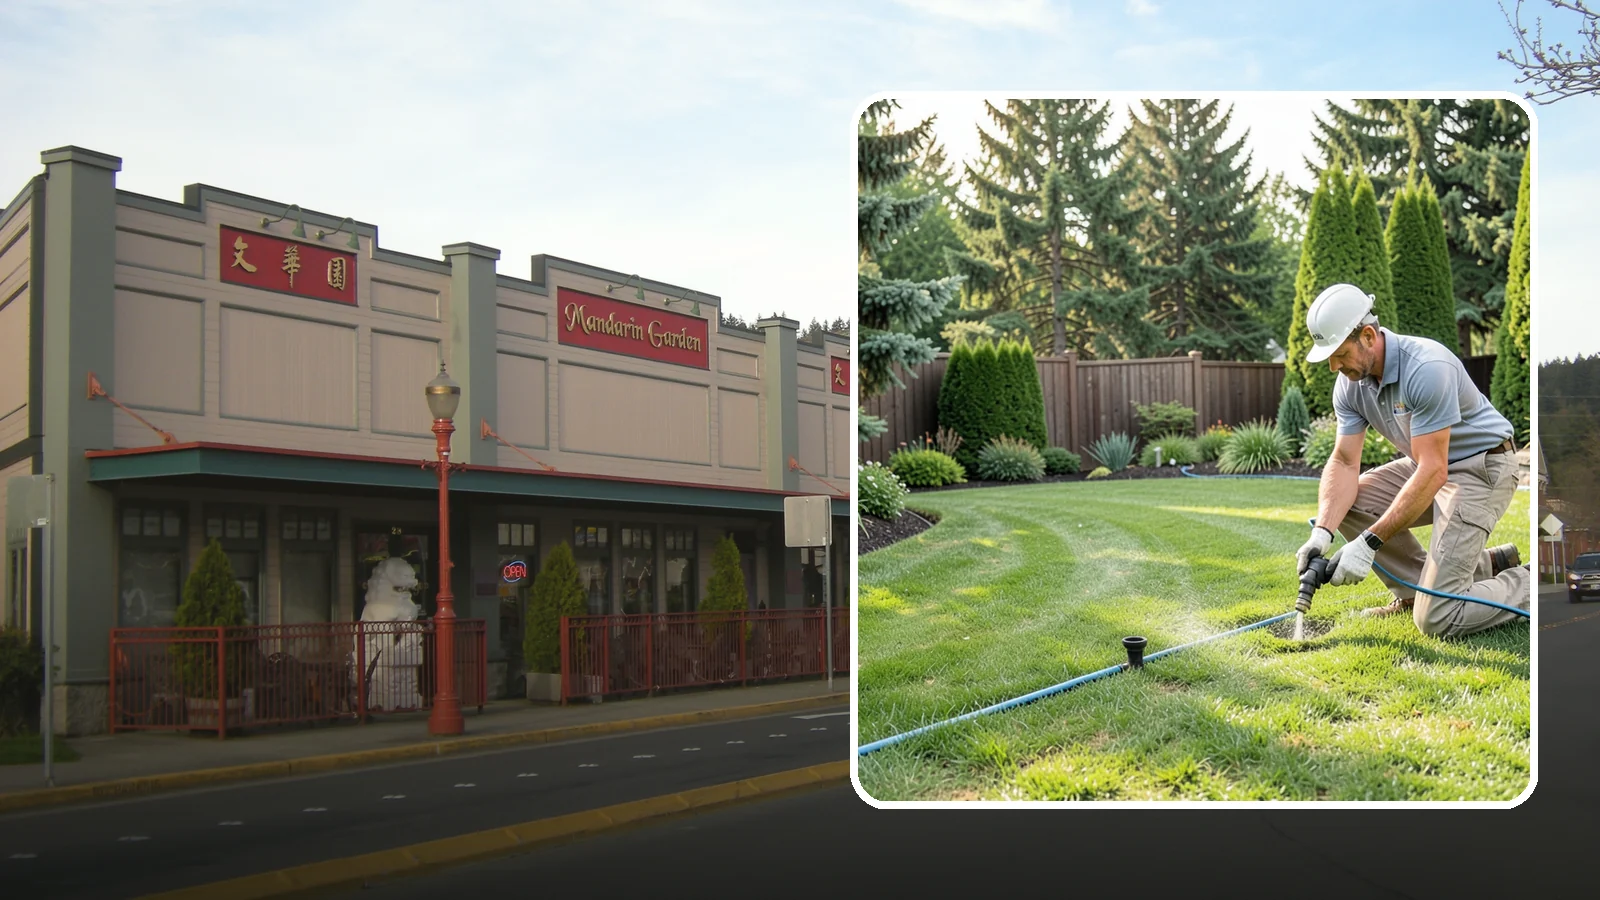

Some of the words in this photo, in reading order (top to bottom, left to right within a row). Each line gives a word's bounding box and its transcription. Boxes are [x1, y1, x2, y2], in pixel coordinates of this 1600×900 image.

[231, 236, 346, 290] 文華園
[564, 302, 644, 341] Mandarin
[648, 320, 701, 352] Garden
[835, 363, 846, 386] 文
[503, 565, 527, 578] OPEN
